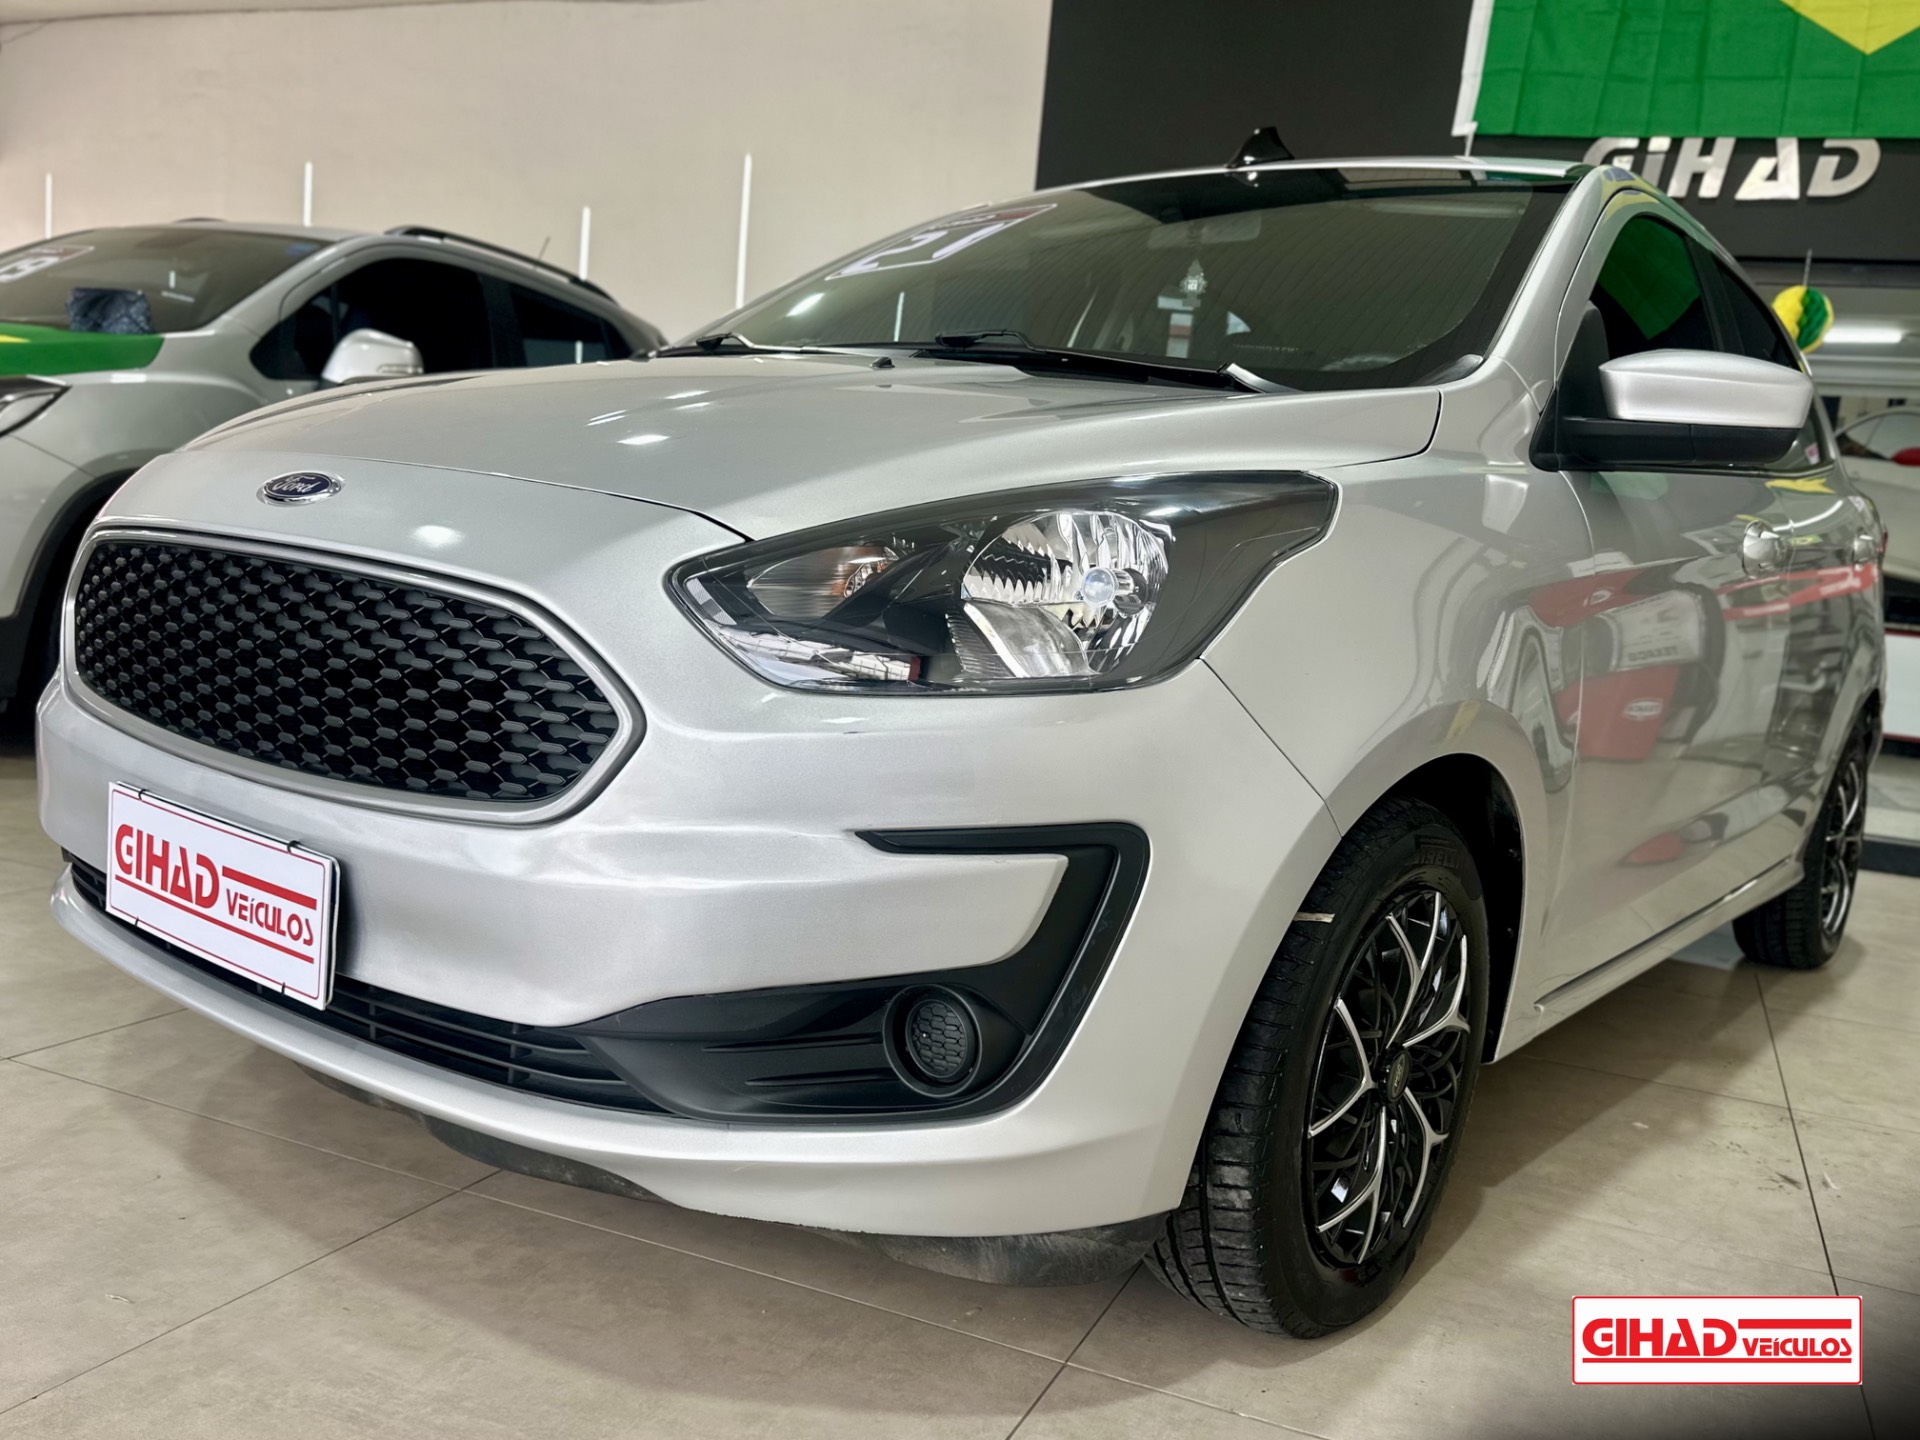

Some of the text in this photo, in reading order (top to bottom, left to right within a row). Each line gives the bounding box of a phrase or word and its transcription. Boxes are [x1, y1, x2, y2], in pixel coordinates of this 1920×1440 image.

[271, 475, 321, 493] Ford
[115, 823, 314, 947] GIHAD VEÍCULOS
